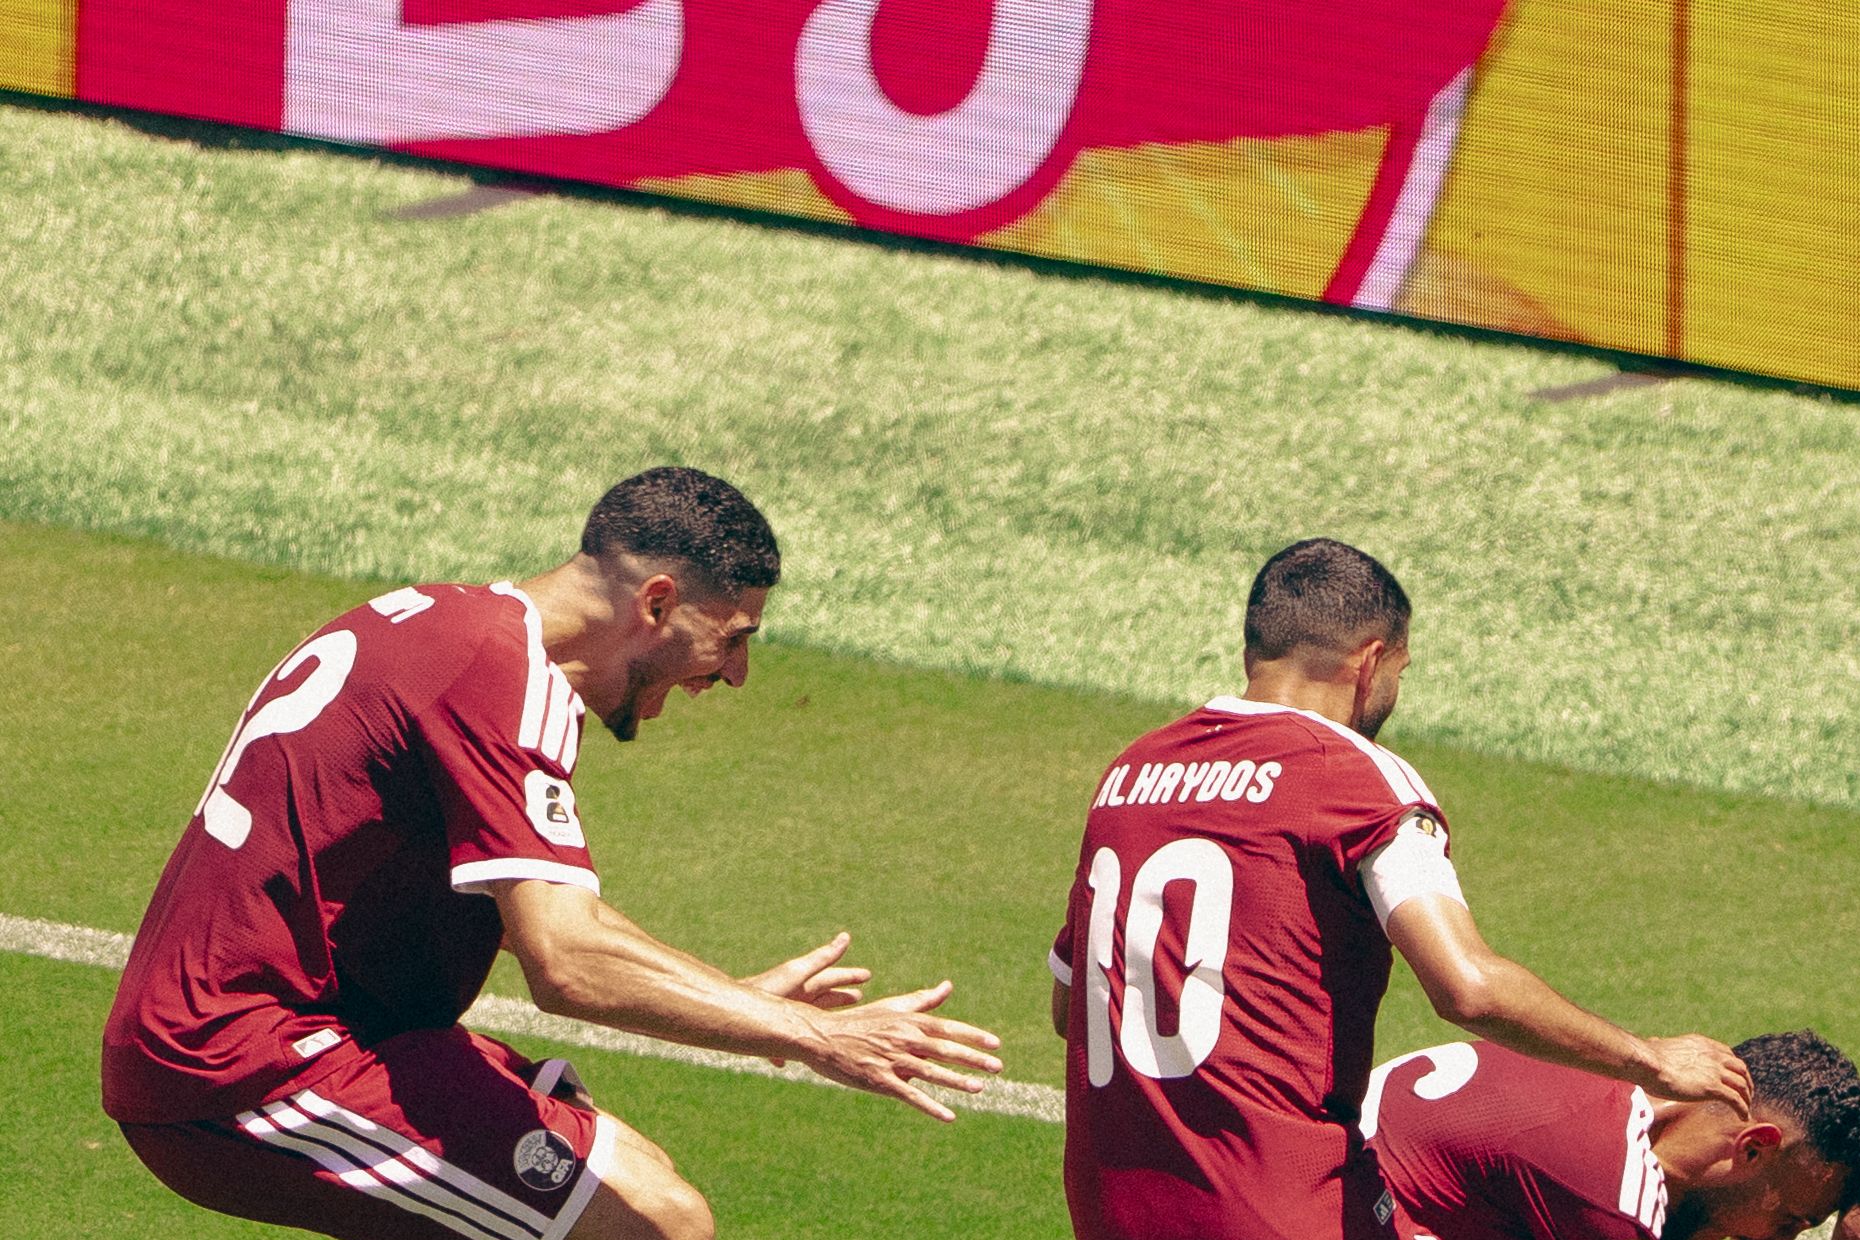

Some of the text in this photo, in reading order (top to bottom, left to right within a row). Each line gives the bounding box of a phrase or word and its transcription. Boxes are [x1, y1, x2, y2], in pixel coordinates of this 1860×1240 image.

[193, 629, 357, 850] 2
[1086, 837, 1235, 1088] 10
[550, 1158, 574, 1184] QFA
